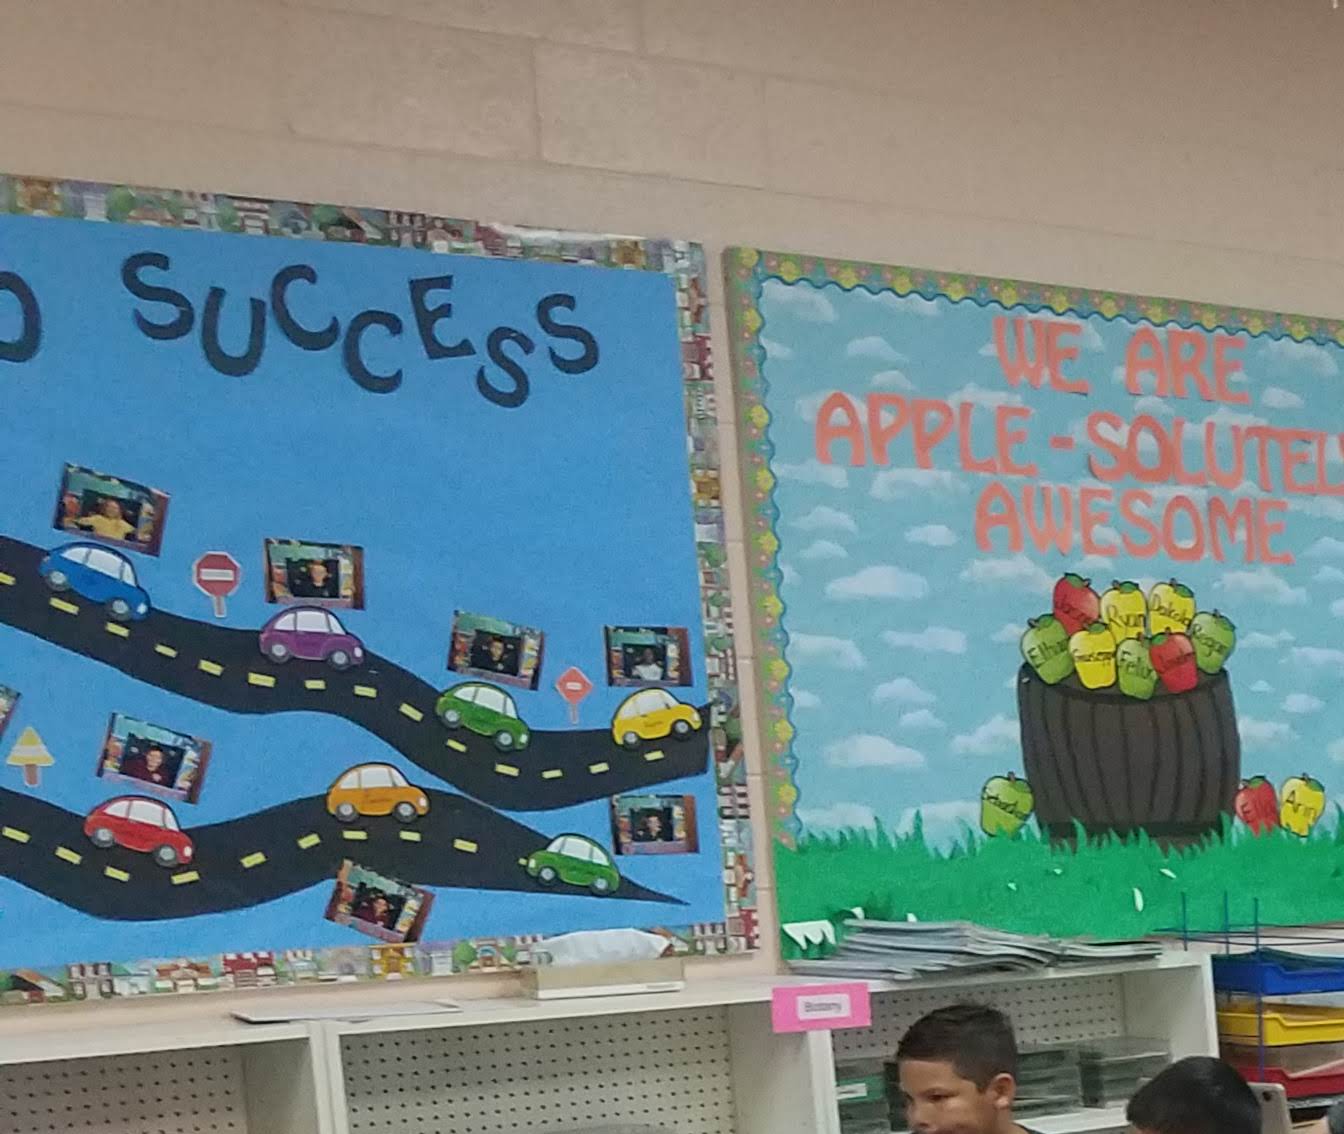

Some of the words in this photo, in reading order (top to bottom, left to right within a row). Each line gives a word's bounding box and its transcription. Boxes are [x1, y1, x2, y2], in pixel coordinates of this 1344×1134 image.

[121, 252, 600, 408] SUCCESS
[993, 315, 1090, 397] WE
[1124, 326, 1251, 403] ARE
[974, 482, 1295, 567] AWESOME
